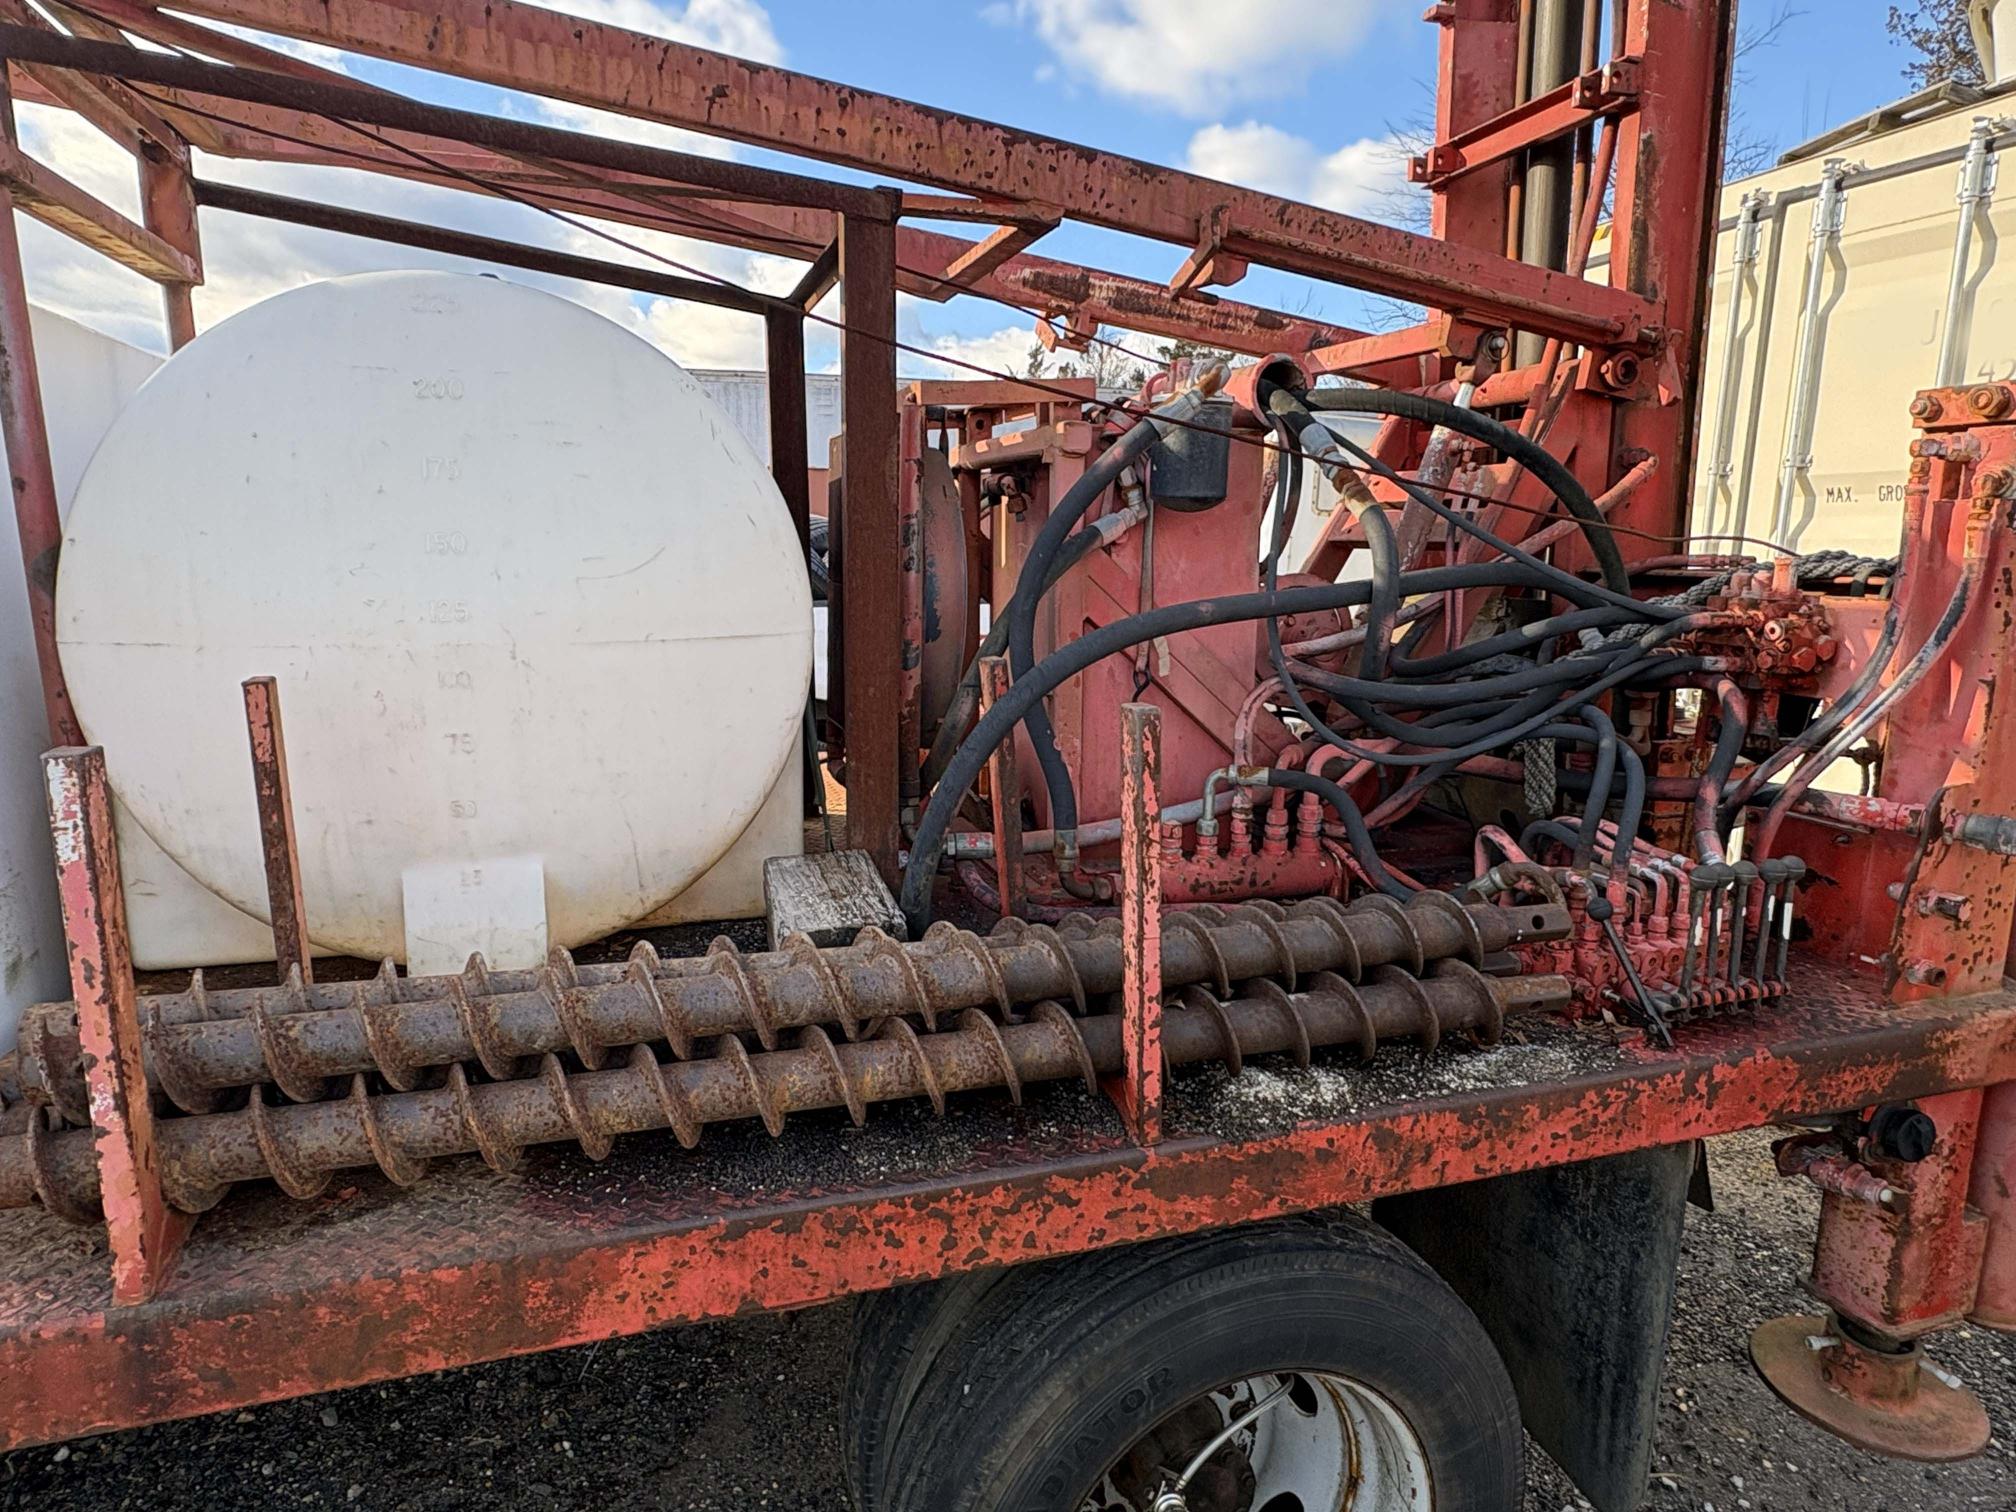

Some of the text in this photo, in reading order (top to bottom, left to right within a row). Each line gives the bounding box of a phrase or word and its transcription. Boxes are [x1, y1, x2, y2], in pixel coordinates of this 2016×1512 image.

[411, 377, 465, 401] 200
[420, 456, 460, 482] 175
[1826, 487, 1859, 504] MAX.
[423, 529, 467, 555] 150
[430, 600, 470, 623] 125
[442, 732, 475, 755] 75
[450, 799, 478, 818] 50
[1030, 1366, 1175, 1511] DIATOR
